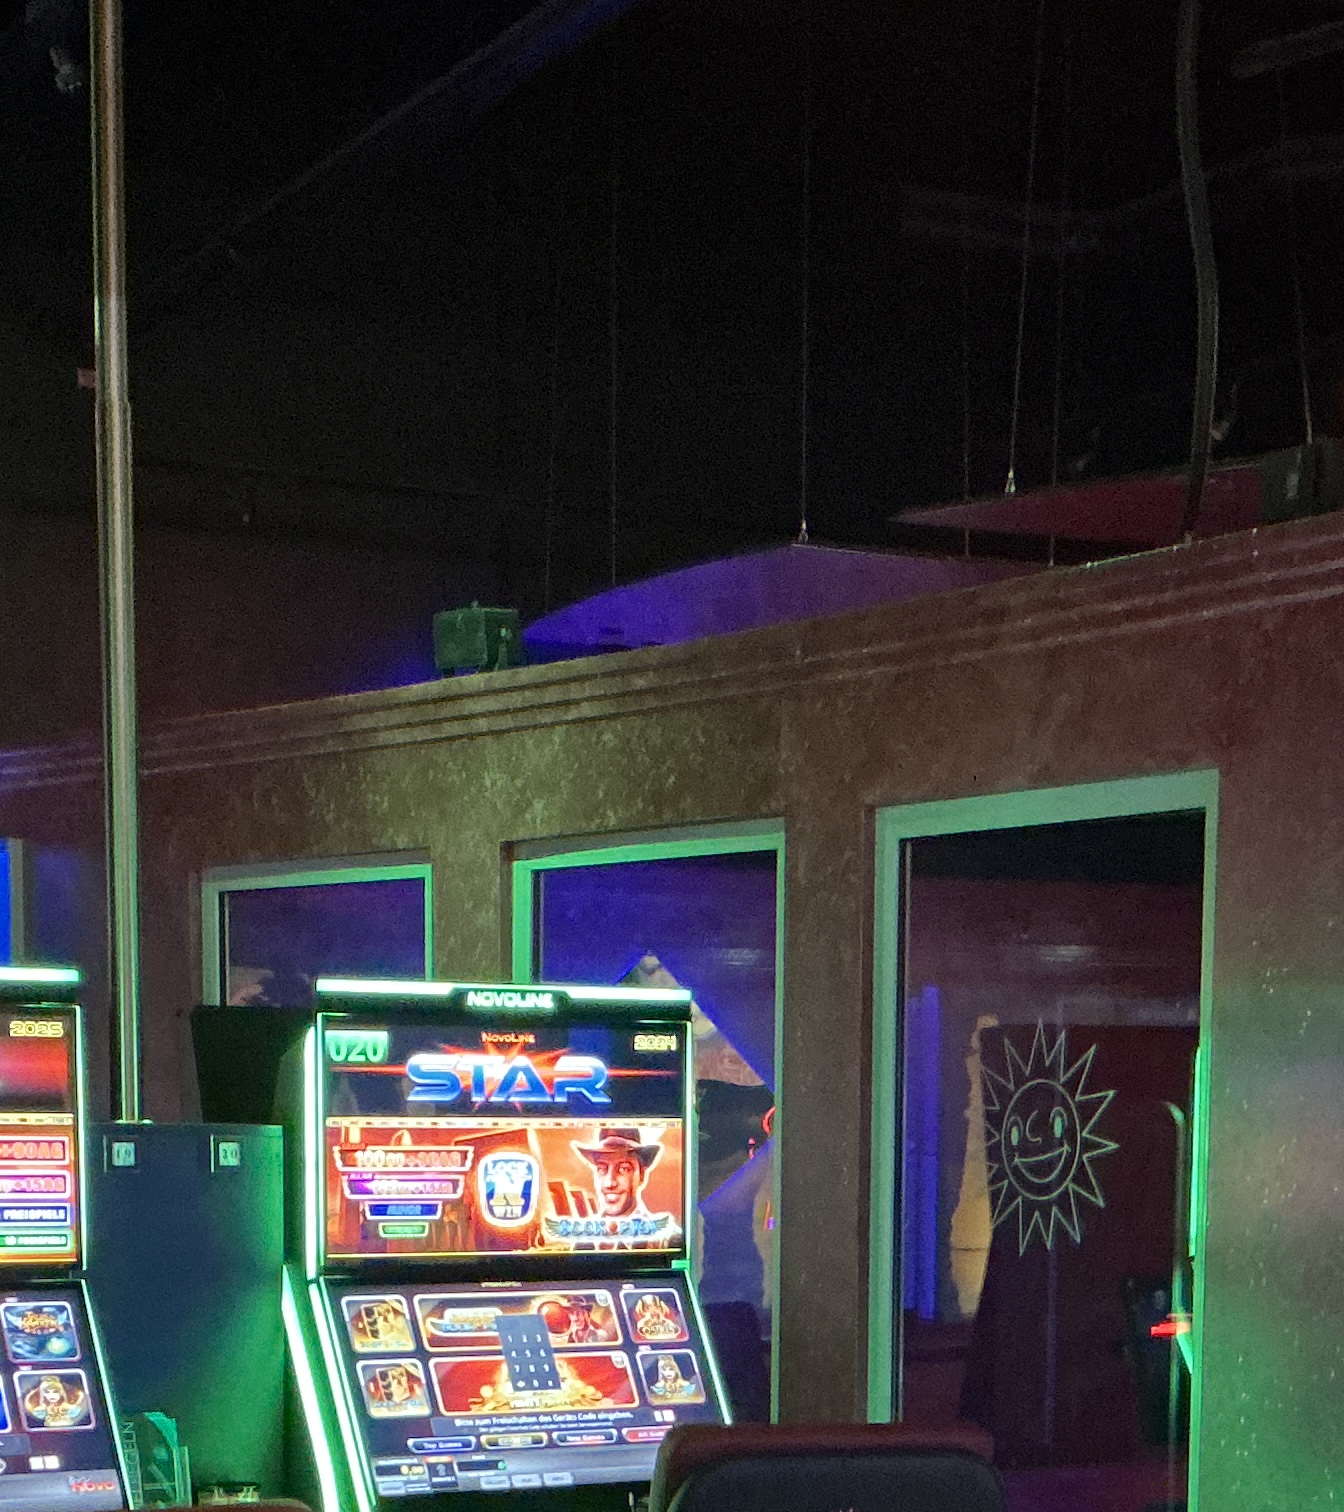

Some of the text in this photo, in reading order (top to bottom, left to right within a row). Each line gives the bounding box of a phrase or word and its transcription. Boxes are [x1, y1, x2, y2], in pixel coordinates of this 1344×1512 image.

[466, 990, 554, 1009] NOVOLINE
[9, 1020, 64, 1038] 2025
[327, 1033, 387, 1062] 020
[406, 1053, 613, 1103] STAR
